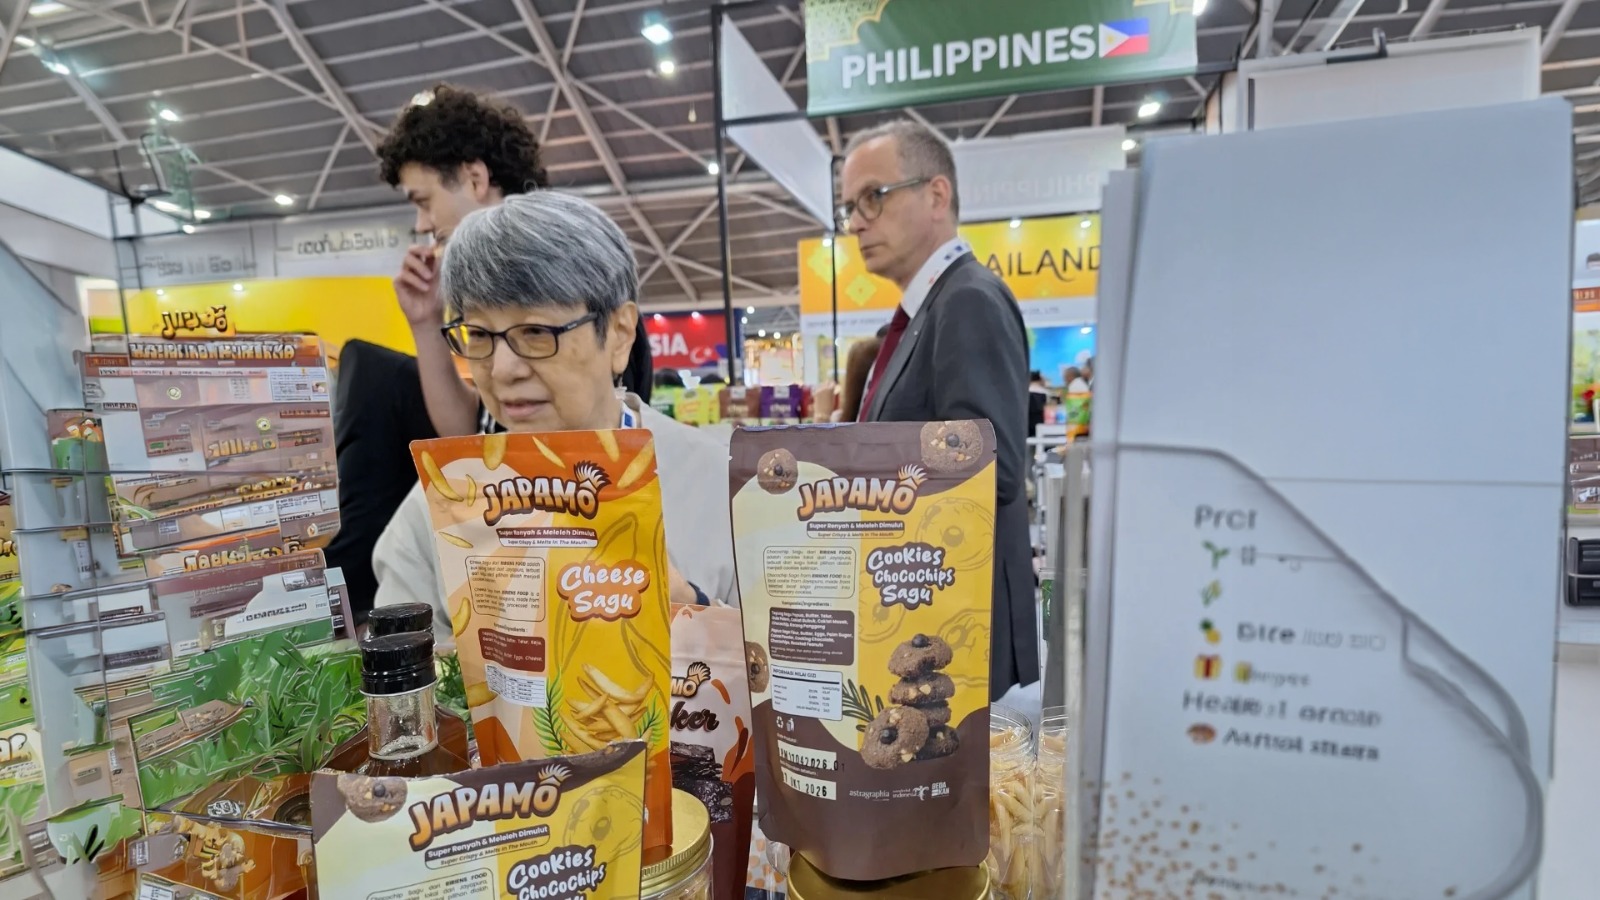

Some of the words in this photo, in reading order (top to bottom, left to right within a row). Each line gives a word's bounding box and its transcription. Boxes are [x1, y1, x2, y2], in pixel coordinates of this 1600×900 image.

[841, 24, 1098, 89] PHILIPPINES
[650, 333, 688, 357] SIA
[560, 566, 645, 592] Cheese
[575, 591, 634, 617] Sagu
[883, 586, 932, 606] Sagu
[805, 783, 828, 797] 2026
[849, 790, 889, 800] astragraphia
[427, 848, 452, 859] Super
[451, 841, 482, 855] Renyah
[482, 840, 488, 848] &
[488, 832, 518, 845] Meleleh
[518, 825, 549, 839] Dimulut
[440, 856, 459, 868] Super
[459, 852, 479, 864] Crispy
[485, 847, 501, 857] Melts
[508, 843, 519, 852] The
[519, 839, 538, 849] Mouth
[408, 888, 424, 897] Sagu
[428, 883, 441, 891] dari
[471, 872, 488, 882] FOOD
[443, 886, 456, 894] dari
